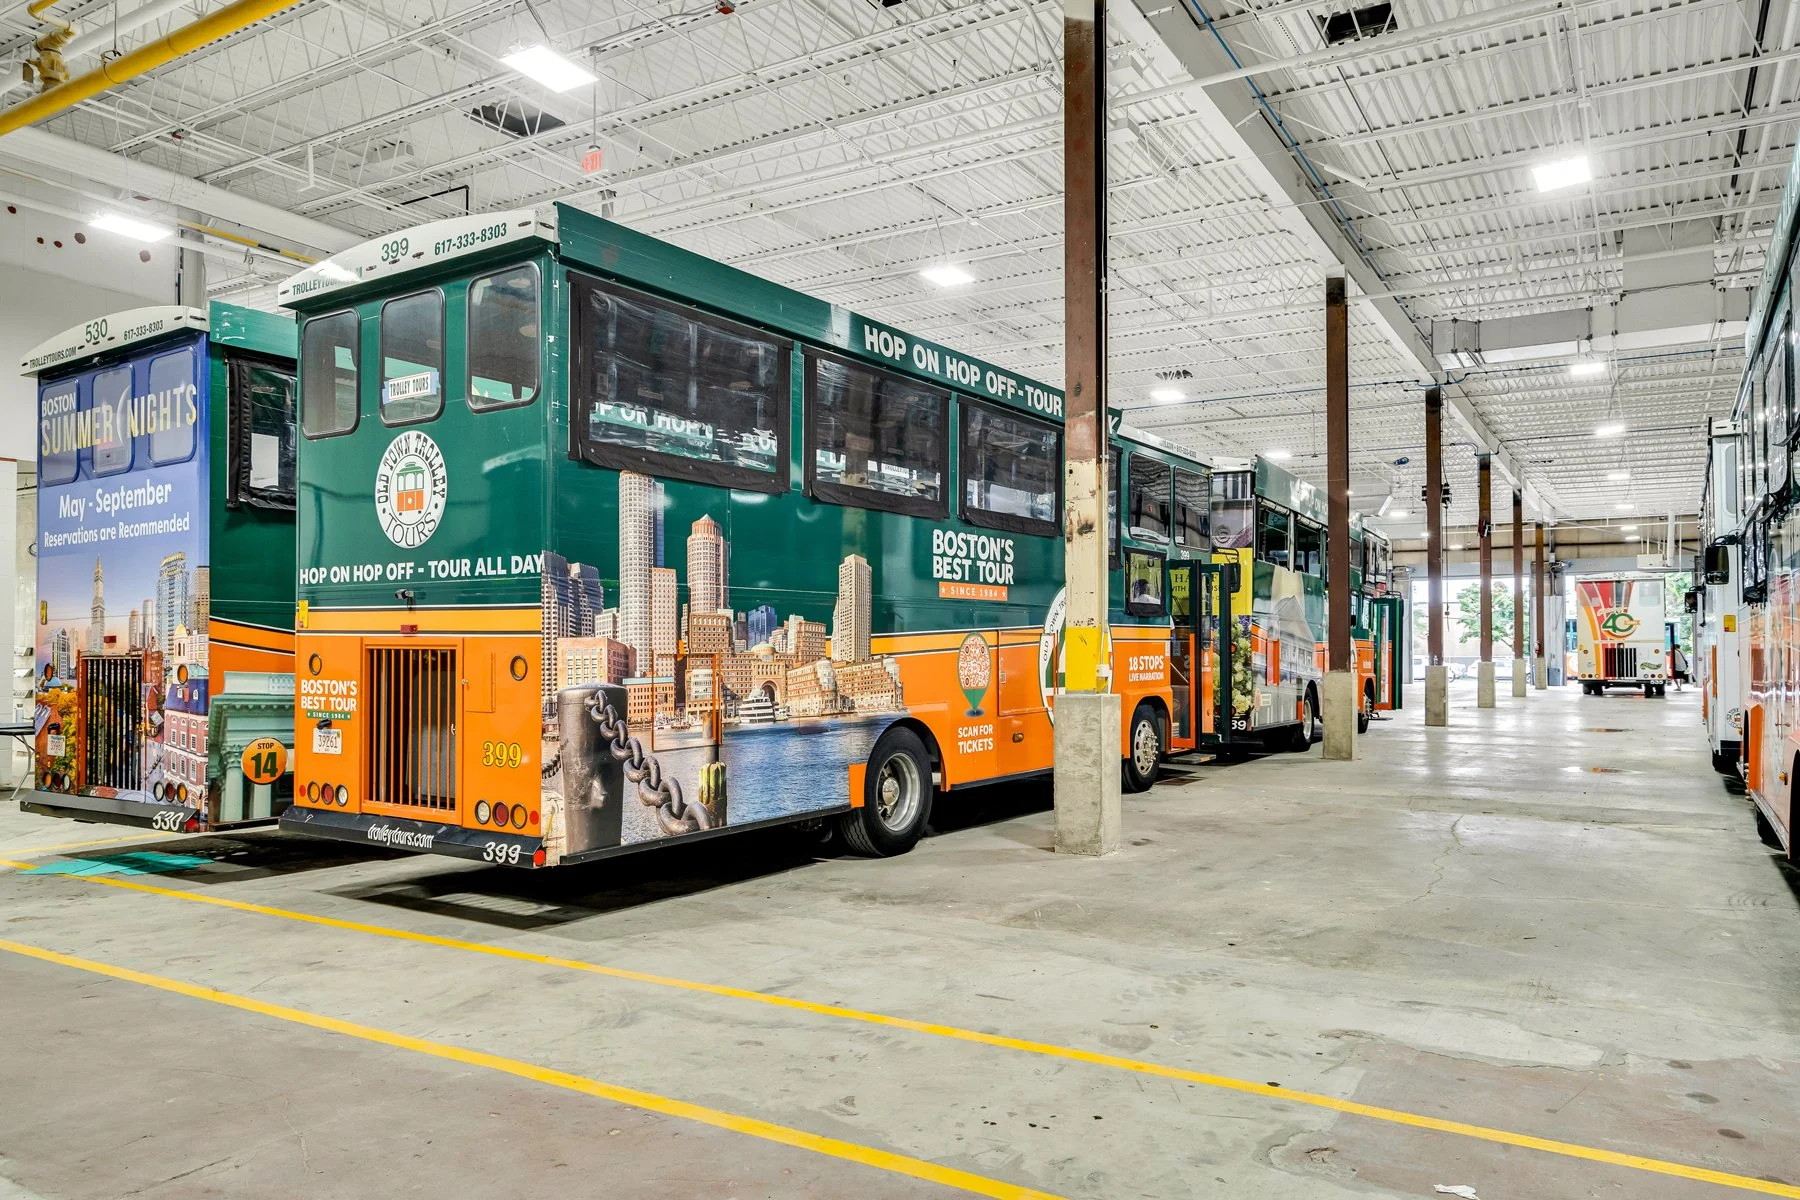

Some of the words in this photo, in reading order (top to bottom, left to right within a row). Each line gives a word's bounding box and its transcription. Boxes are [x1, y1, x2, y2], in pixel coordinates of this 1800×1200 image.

[381, 237, 409, 262] 399
[434, 223, 507, 256] 617-333-8303
[85, 319, 108, 343] 530
[123, 320, 164, 341] 617-333-8303
[29, 347, 77, 369] TROLLEYTOURS.COM
[864, 324, 907, 361] HOP
[913, 344, 940, 375] ON
[946, 355, 981, 387] HOP
[389, 379, 411, 396] TROLLEY
[412, 375, 430, 392] TOURS
[41, 392, 77, 418] BOSTON
[41, 404, 114, 457] SUMMER
[126, 384, 197, 440] NIGHTS
[383, 434, 411, 471] TOWN
[415, 433, 446, 499] TROLLEY
[59, 494, 85, 521] May
[96, 479, 172, 517] September
[377, 474, 390, 505] OLD
[44, 525, 98, 548] Reservations
[100, 525, 117, 541] are
[118, 512, 190, 540] Recommended
[386, 511, 437, 547] TOURS
[933, 529, 1014, 563] BOSTON'S
[1180, 550, 1190, 560] 399
[300, 567, 328, 585] HOP
[330, 566, 350, 583] ON
[353, 564, 383, 582] HOP
[386, 562, 414, 581] OFF
[428, 559, 471, 578] TOUR
[475, 556, 507, 576] ALL
[511, 554, 546, 574] DAY
[933, 556, 973, 582] BEST
[976, 560, 1014, 585] TOUR
[950, 587, 976, 597] SINCE
[979, 588, 998, 598] 1984
[1128, 656, 1139, 671] 18
[1139, 655, 1164, 671] STOPS
[301, 679, 358, 696] BOSTON'S
[1128, 673, 1140, 682] LIVE
[301, 696, 326, 710] BEST
[329, 697, 357, 711] TOUR
[318, 734, 338, 749] 39261
[958, 726, 978, 738] SCAN
[979, 724, 993, 736] FOR
[257, 742, 275, 750] STOP
[482, 741, 522, 768] 399
[958, 738, 994, 754] TICKETS
[250, 751, 279, 778] 14
[152, 811, 184, 831] 530
[367, 824, 435, 849] trolleytours.com
[482, 841, 522, 865] 399
